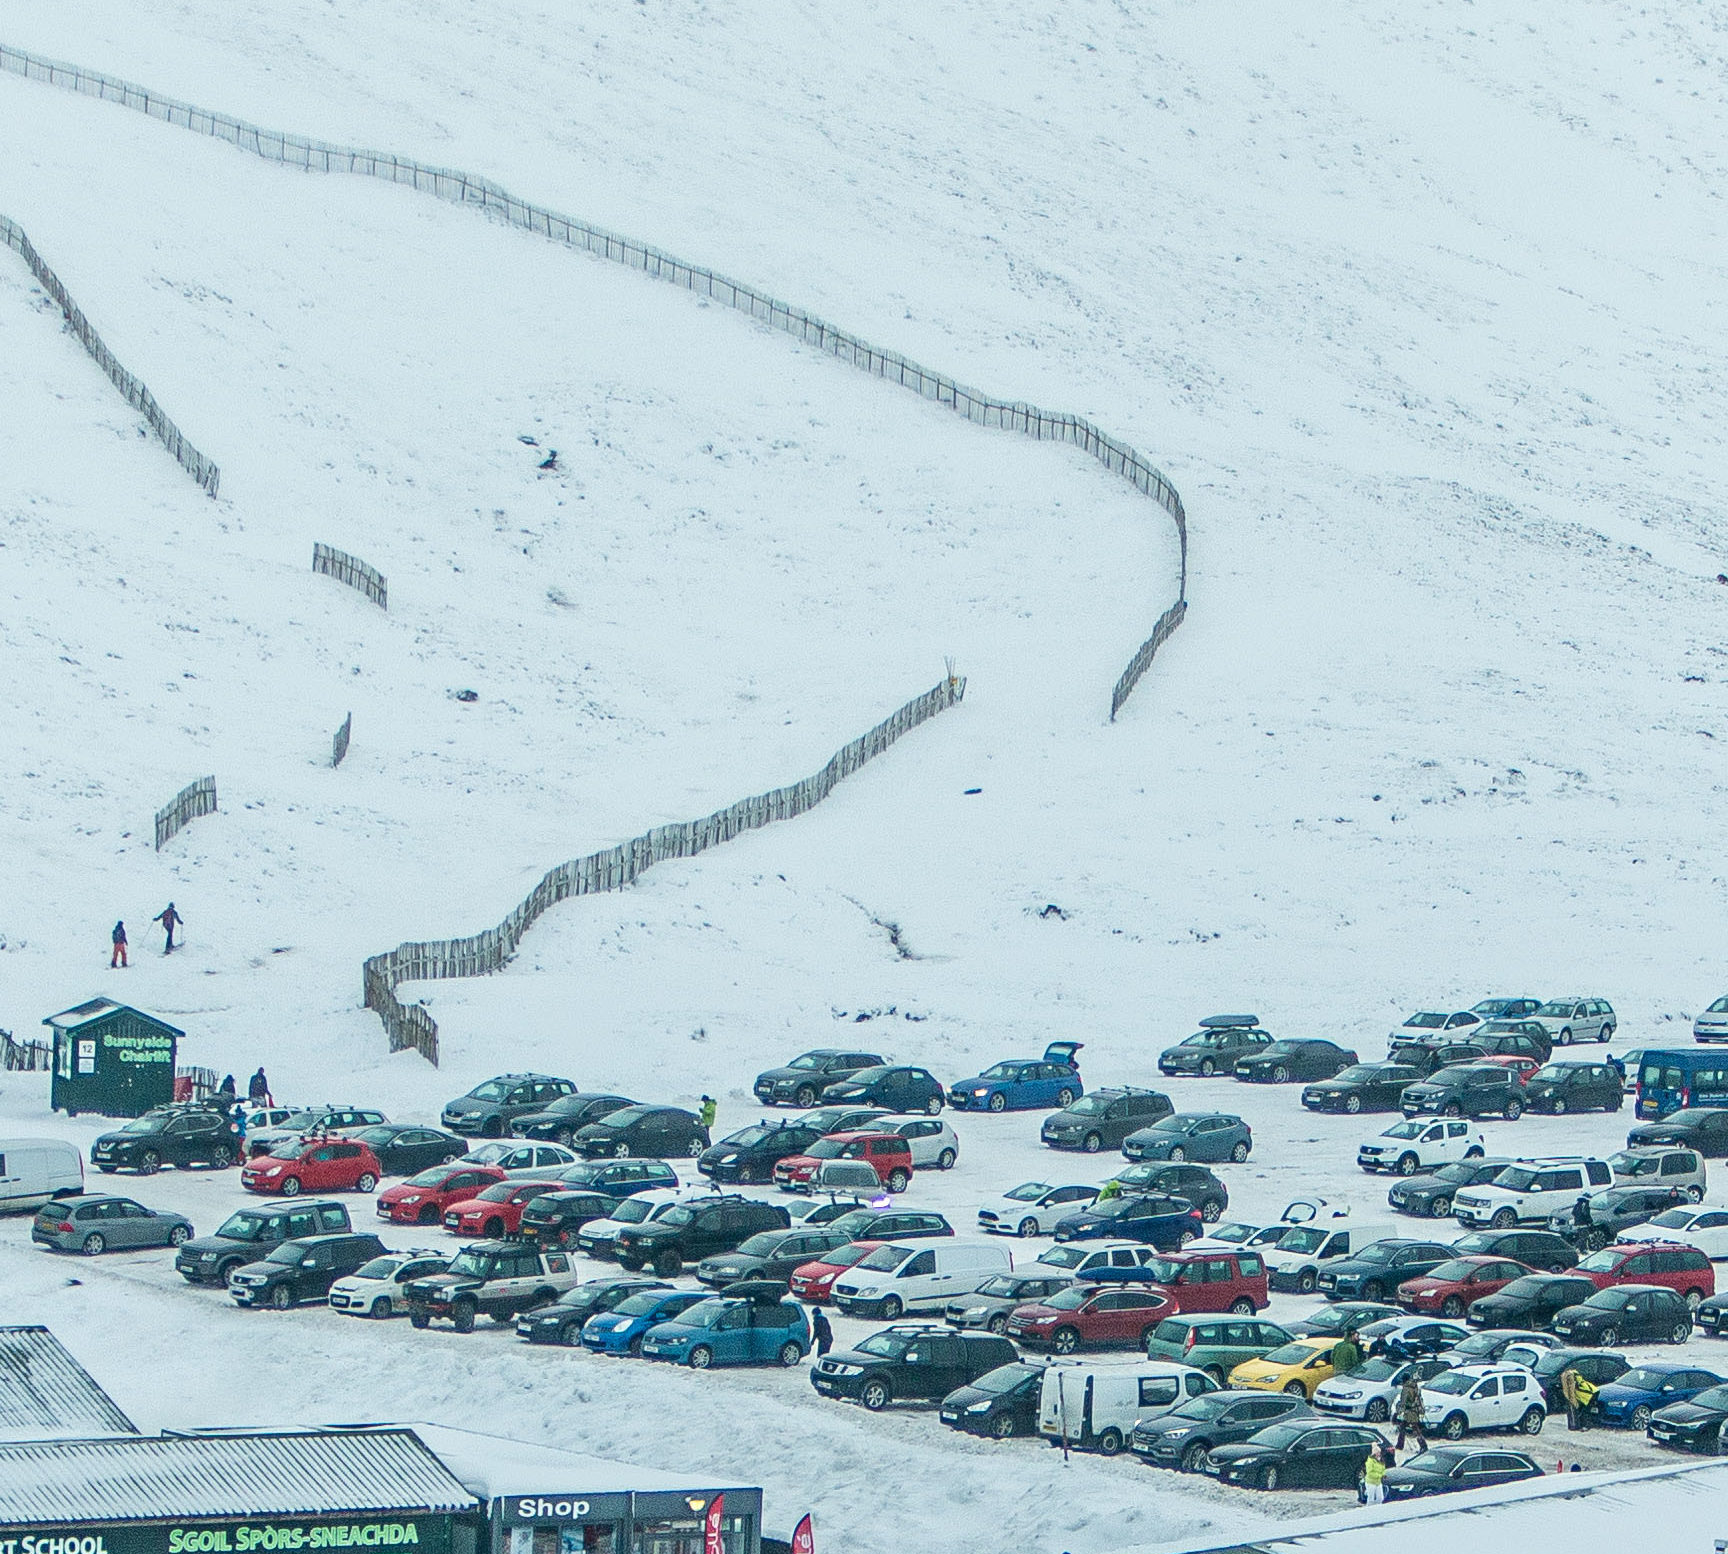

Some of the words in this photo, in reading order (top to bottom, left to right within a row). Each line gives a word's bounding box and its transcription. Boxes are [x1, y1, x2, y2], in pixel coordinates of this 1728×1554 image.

[81, 1044, 93, 1054] 12
[103, 1034, 172, 1050] Sunnyside
[119, 1049, 172, 1063] Chairlift
[517, 1498, 591, 1520] Shop
[168, 1529, 232, 1553] SGOIL
